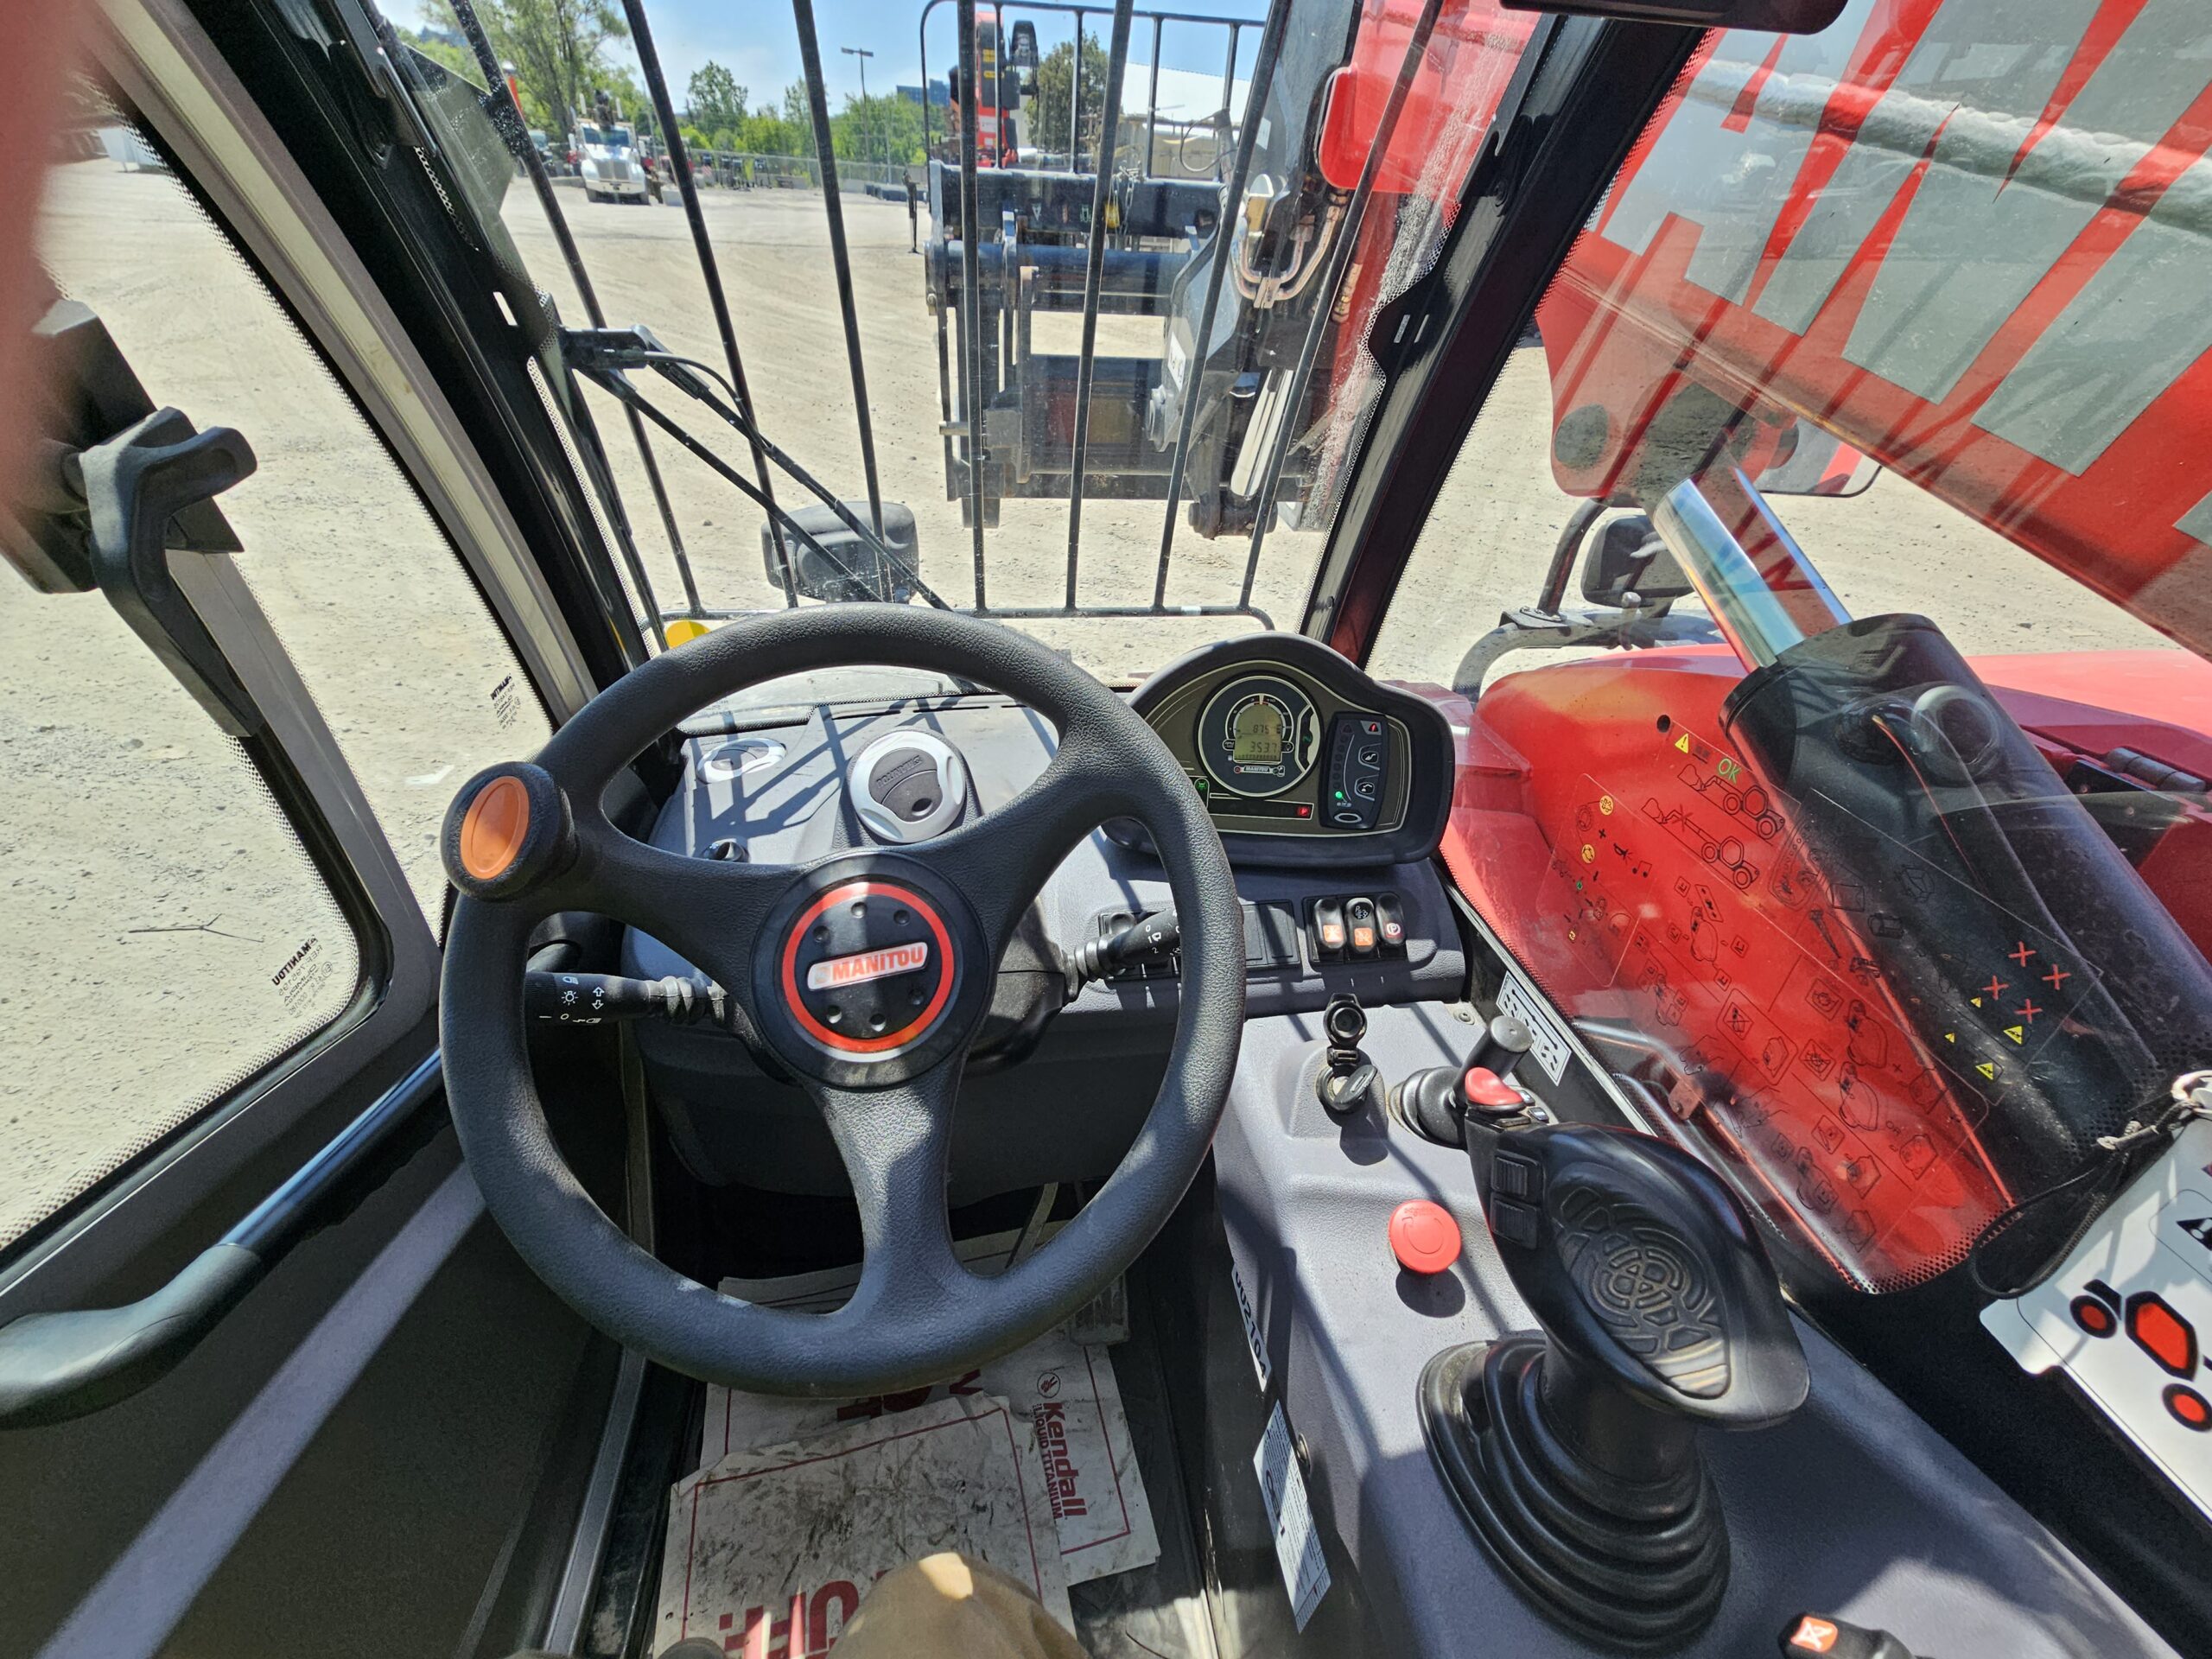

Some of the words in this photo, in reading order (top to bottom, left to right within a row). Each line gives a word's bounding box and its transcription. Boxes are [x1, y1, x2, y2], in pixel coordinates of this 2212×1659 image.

[1250, 741, 1277, 753] 3537
[1718, 758, 1742, 785] OK
[1033, 1406, 1050, 1449] LIQUID
[1044, 1402, 1087, 1516] Kendall
[1041, 1450, 1064, 1519] TITANIUM
